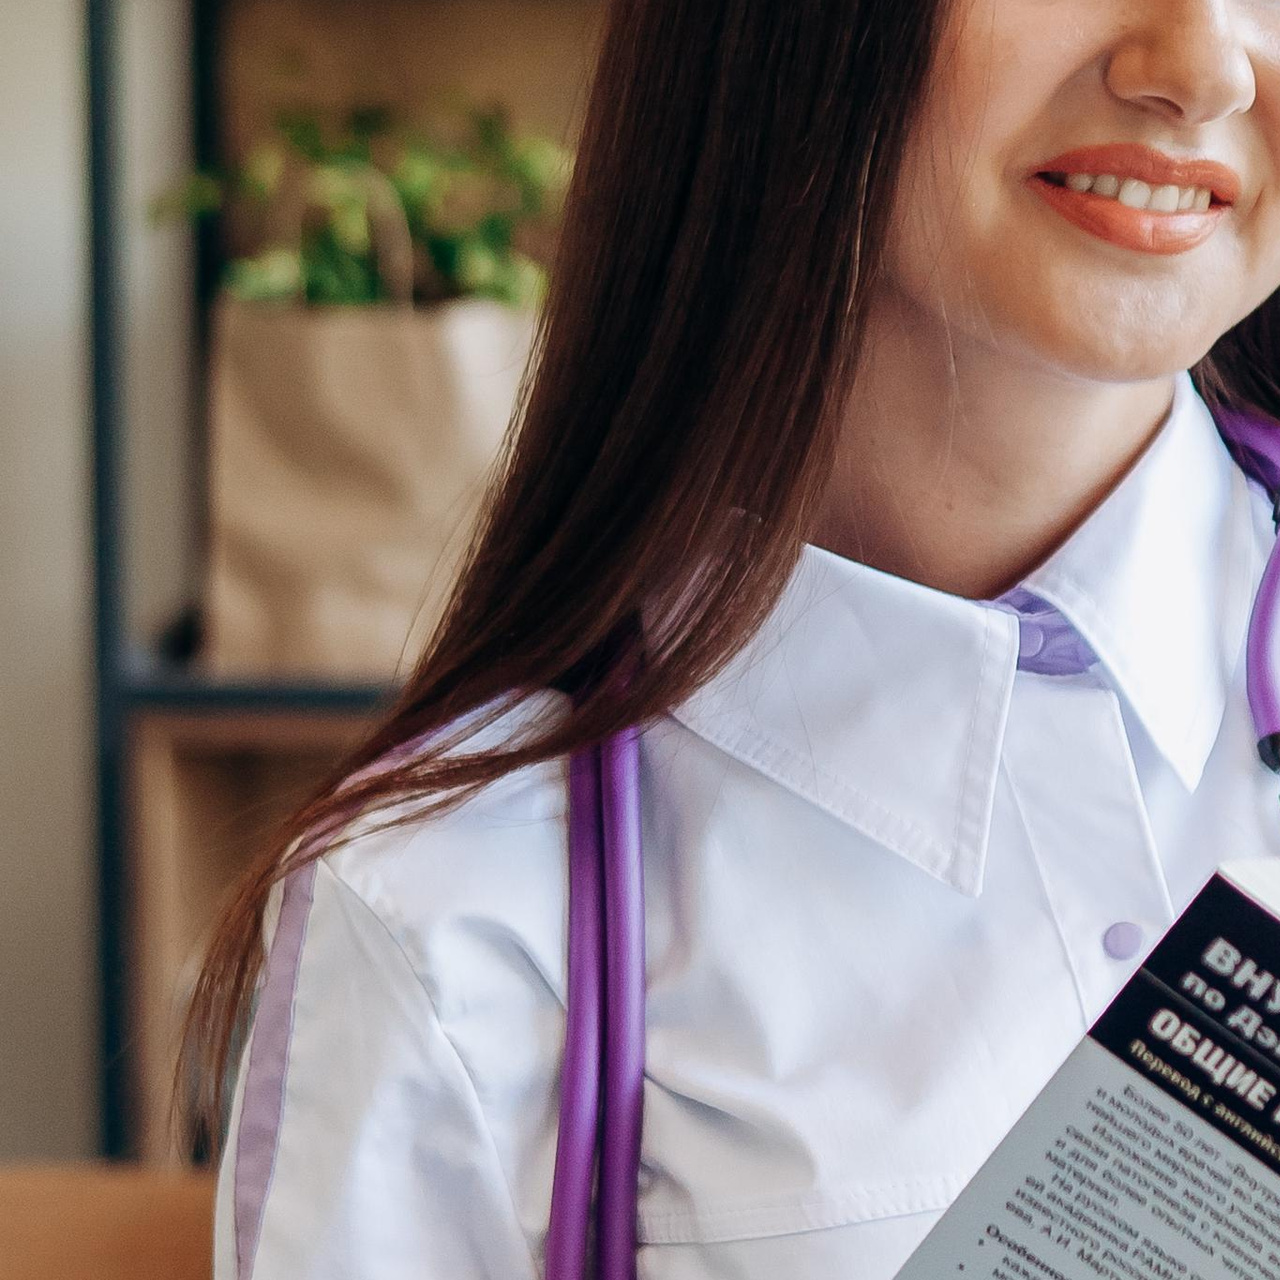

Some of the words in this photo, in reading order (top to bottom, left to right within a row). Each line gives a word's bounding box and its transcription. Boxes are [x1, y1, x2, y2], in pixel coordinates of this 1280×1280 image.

[1178, 969, 1230, 1013] по
[1125, 1037, 1205, 1103] Перевод
[1198, 1092, 1214, 1107] с
[1140, 1006, 1278, 1115] ОБЩИЕ
